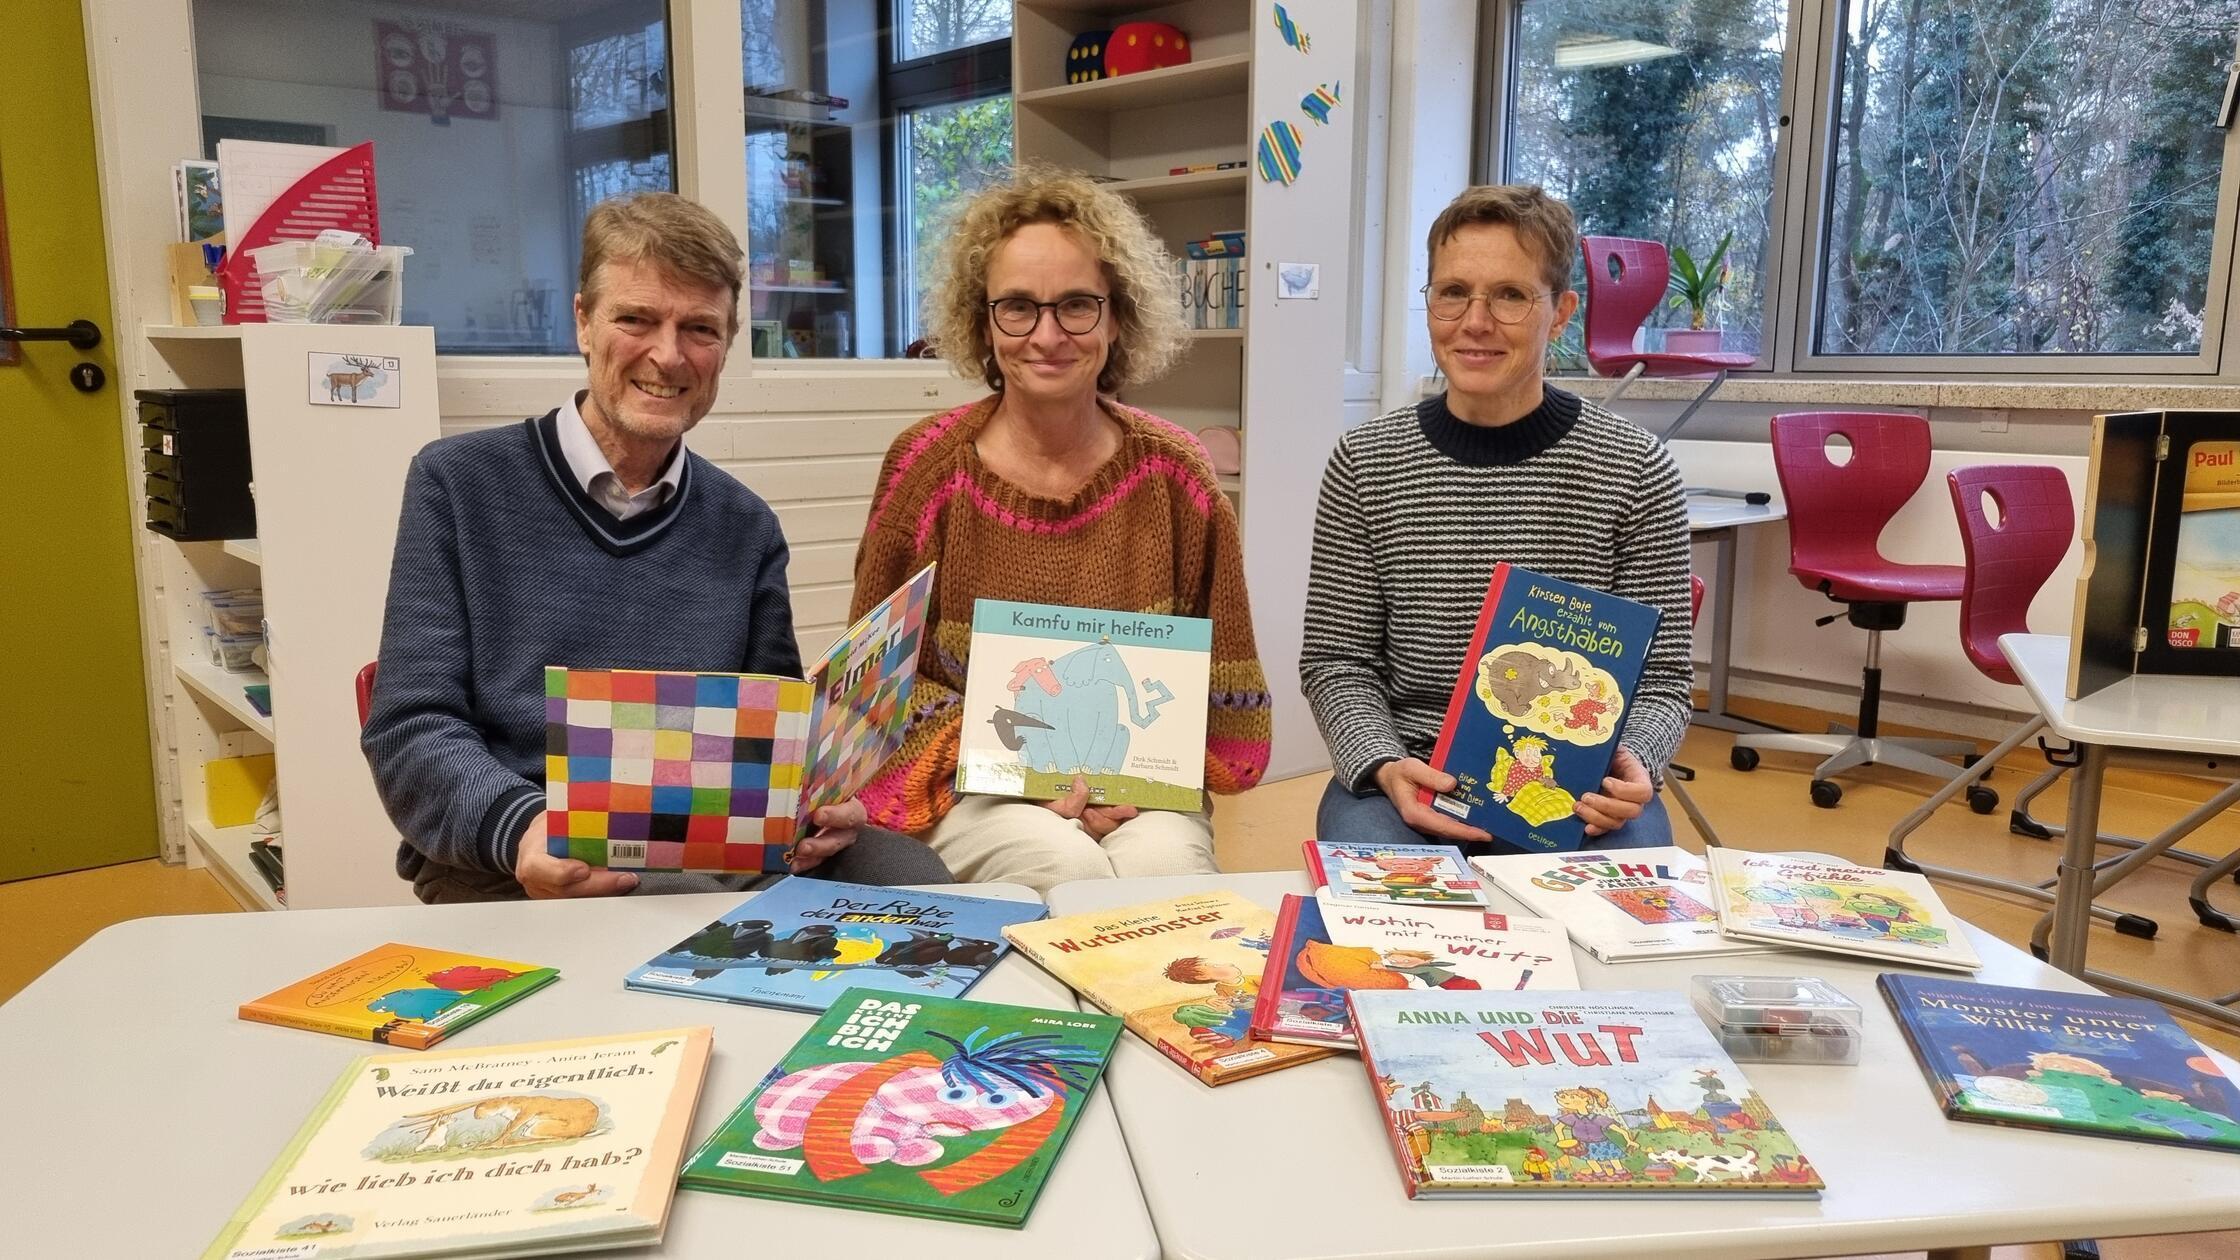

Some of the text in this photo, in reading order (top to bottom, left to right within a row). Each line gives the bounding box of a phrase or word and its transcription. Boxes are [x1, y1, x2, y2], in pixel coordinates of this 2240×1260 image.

[2194, 449, 2233, 468] Paul
[1527, 584, 1592, 614] Kirsten Boie
[1011, 611, 1175, 640] Kamfu mir helfen?
[1556, 606, 1617, 635] erzählt vom
[1509, 606, 1624, 659] Angsthaben
[2171, 631, 2190, 639] DON
[829, 625, 901, 703] Elmar
[1742, 858, 1774, 868] Ich
[1779, 863, 1822, 872] und
[1826, 865, 1886, 876] meine
[1776, 869, 1864, 882] Gefühle
[831, 898, 954, 919] Der Rabe
[800, 908, 954, 929] der anders war
[1093, 915, 1161, 933] Das kleine
[1342, 915, 1435, 929] Wohin
[1048, 911, 1224, 953] Wutmonster
[1385, 930, 1509, 945] mit meiner
[1447, 943, 1553, 967] Wut?
[854, 1008, 913, 1020] KLEINE
[858, 998, 922, 1015] DAS
[1919, 997, 2054, 1021] Monster
[2065, 1015, 2158, 1032] unter
[845, 1013, 910, 1030] ICH
[1031, 1017, 1097, 1029] MIRA LOBE
[1397, 1011, 1471, 1025] ANNA
[1477, 1011, 1534, 1025] UND
[836, 1023, 902, 1041] BIN
[1960, 1013, 2136, 1043] Willis Bett
[826, 1034, 894, 1052] ICH
[408, 1050, 637, 1076] Sam McBratney Anita Jeram
[375, 1080, 461, 1099] Weißt
[467, 1077, 503, 1092] du
[289, 1146, 643, 1197] wie lieb ich dich hab?
[724, 1158, 777, 1170] Sozialkiste
[1439, 1166, 1495, 1174] Sozialkiste
[374, 1217, 420, 1229] Verlag
[231, 1245, 299, 1258] Sozialkiste
